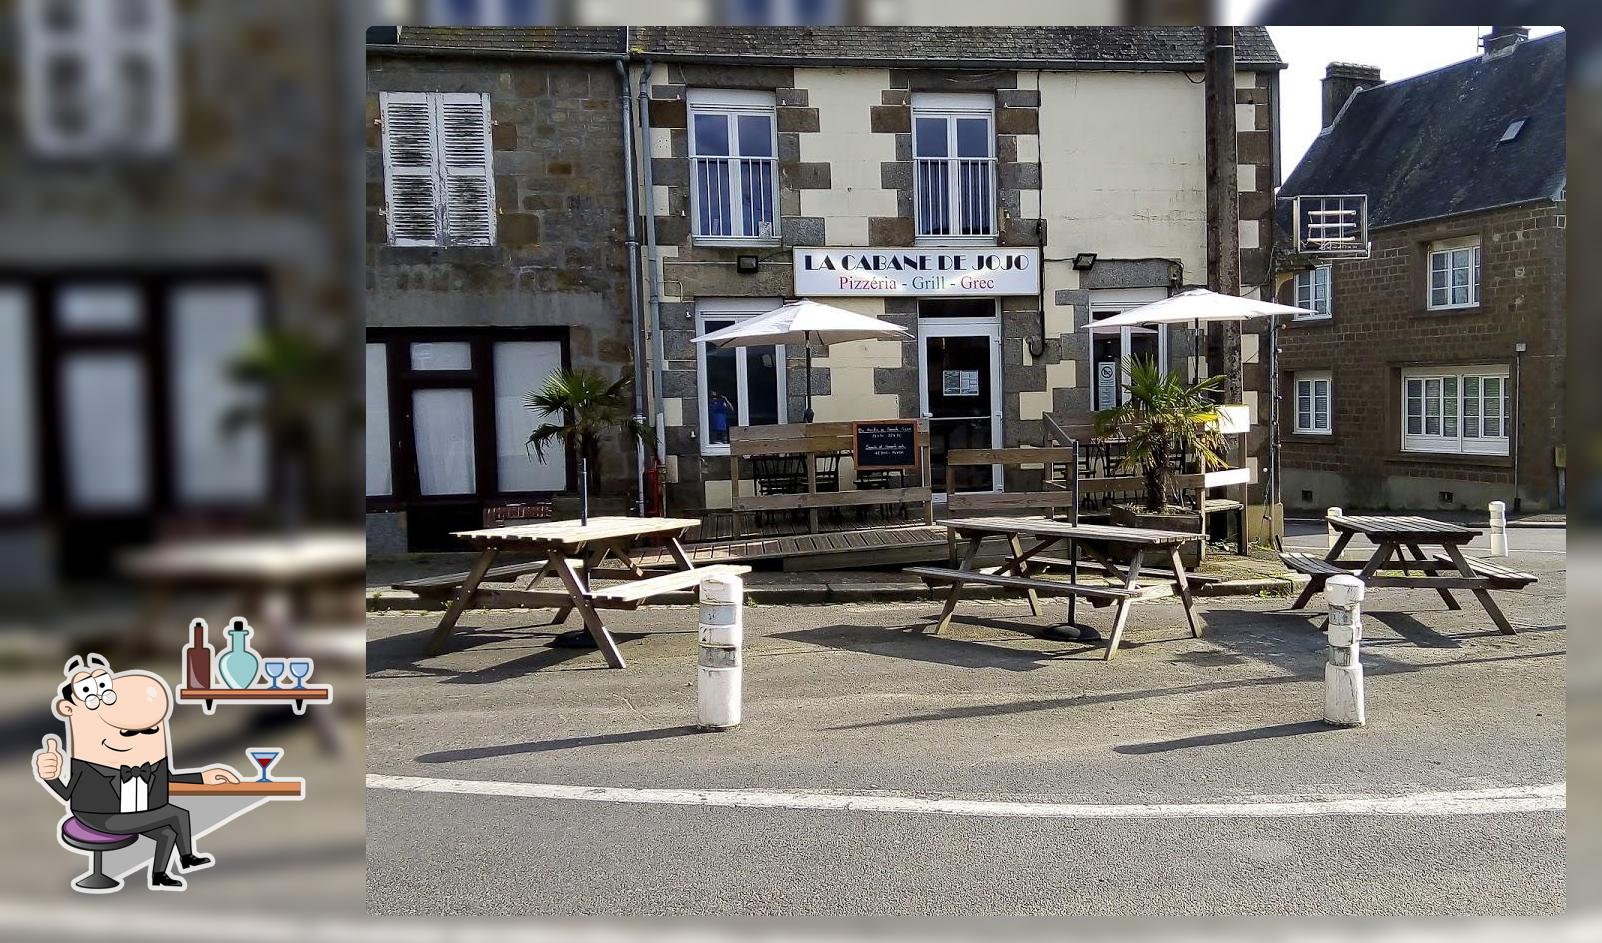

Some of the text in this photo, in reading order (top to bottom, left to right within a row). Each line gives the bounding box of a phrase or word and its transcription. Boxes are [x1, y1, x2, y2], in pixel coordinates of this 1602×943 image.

[804, 254, 1030, 271] LA CABANE DE JOJO
[839, 276, 897, 290] Pizzéria
[912, 276, 945, 290] Grill
[960, 276, 995, 290] Grec
